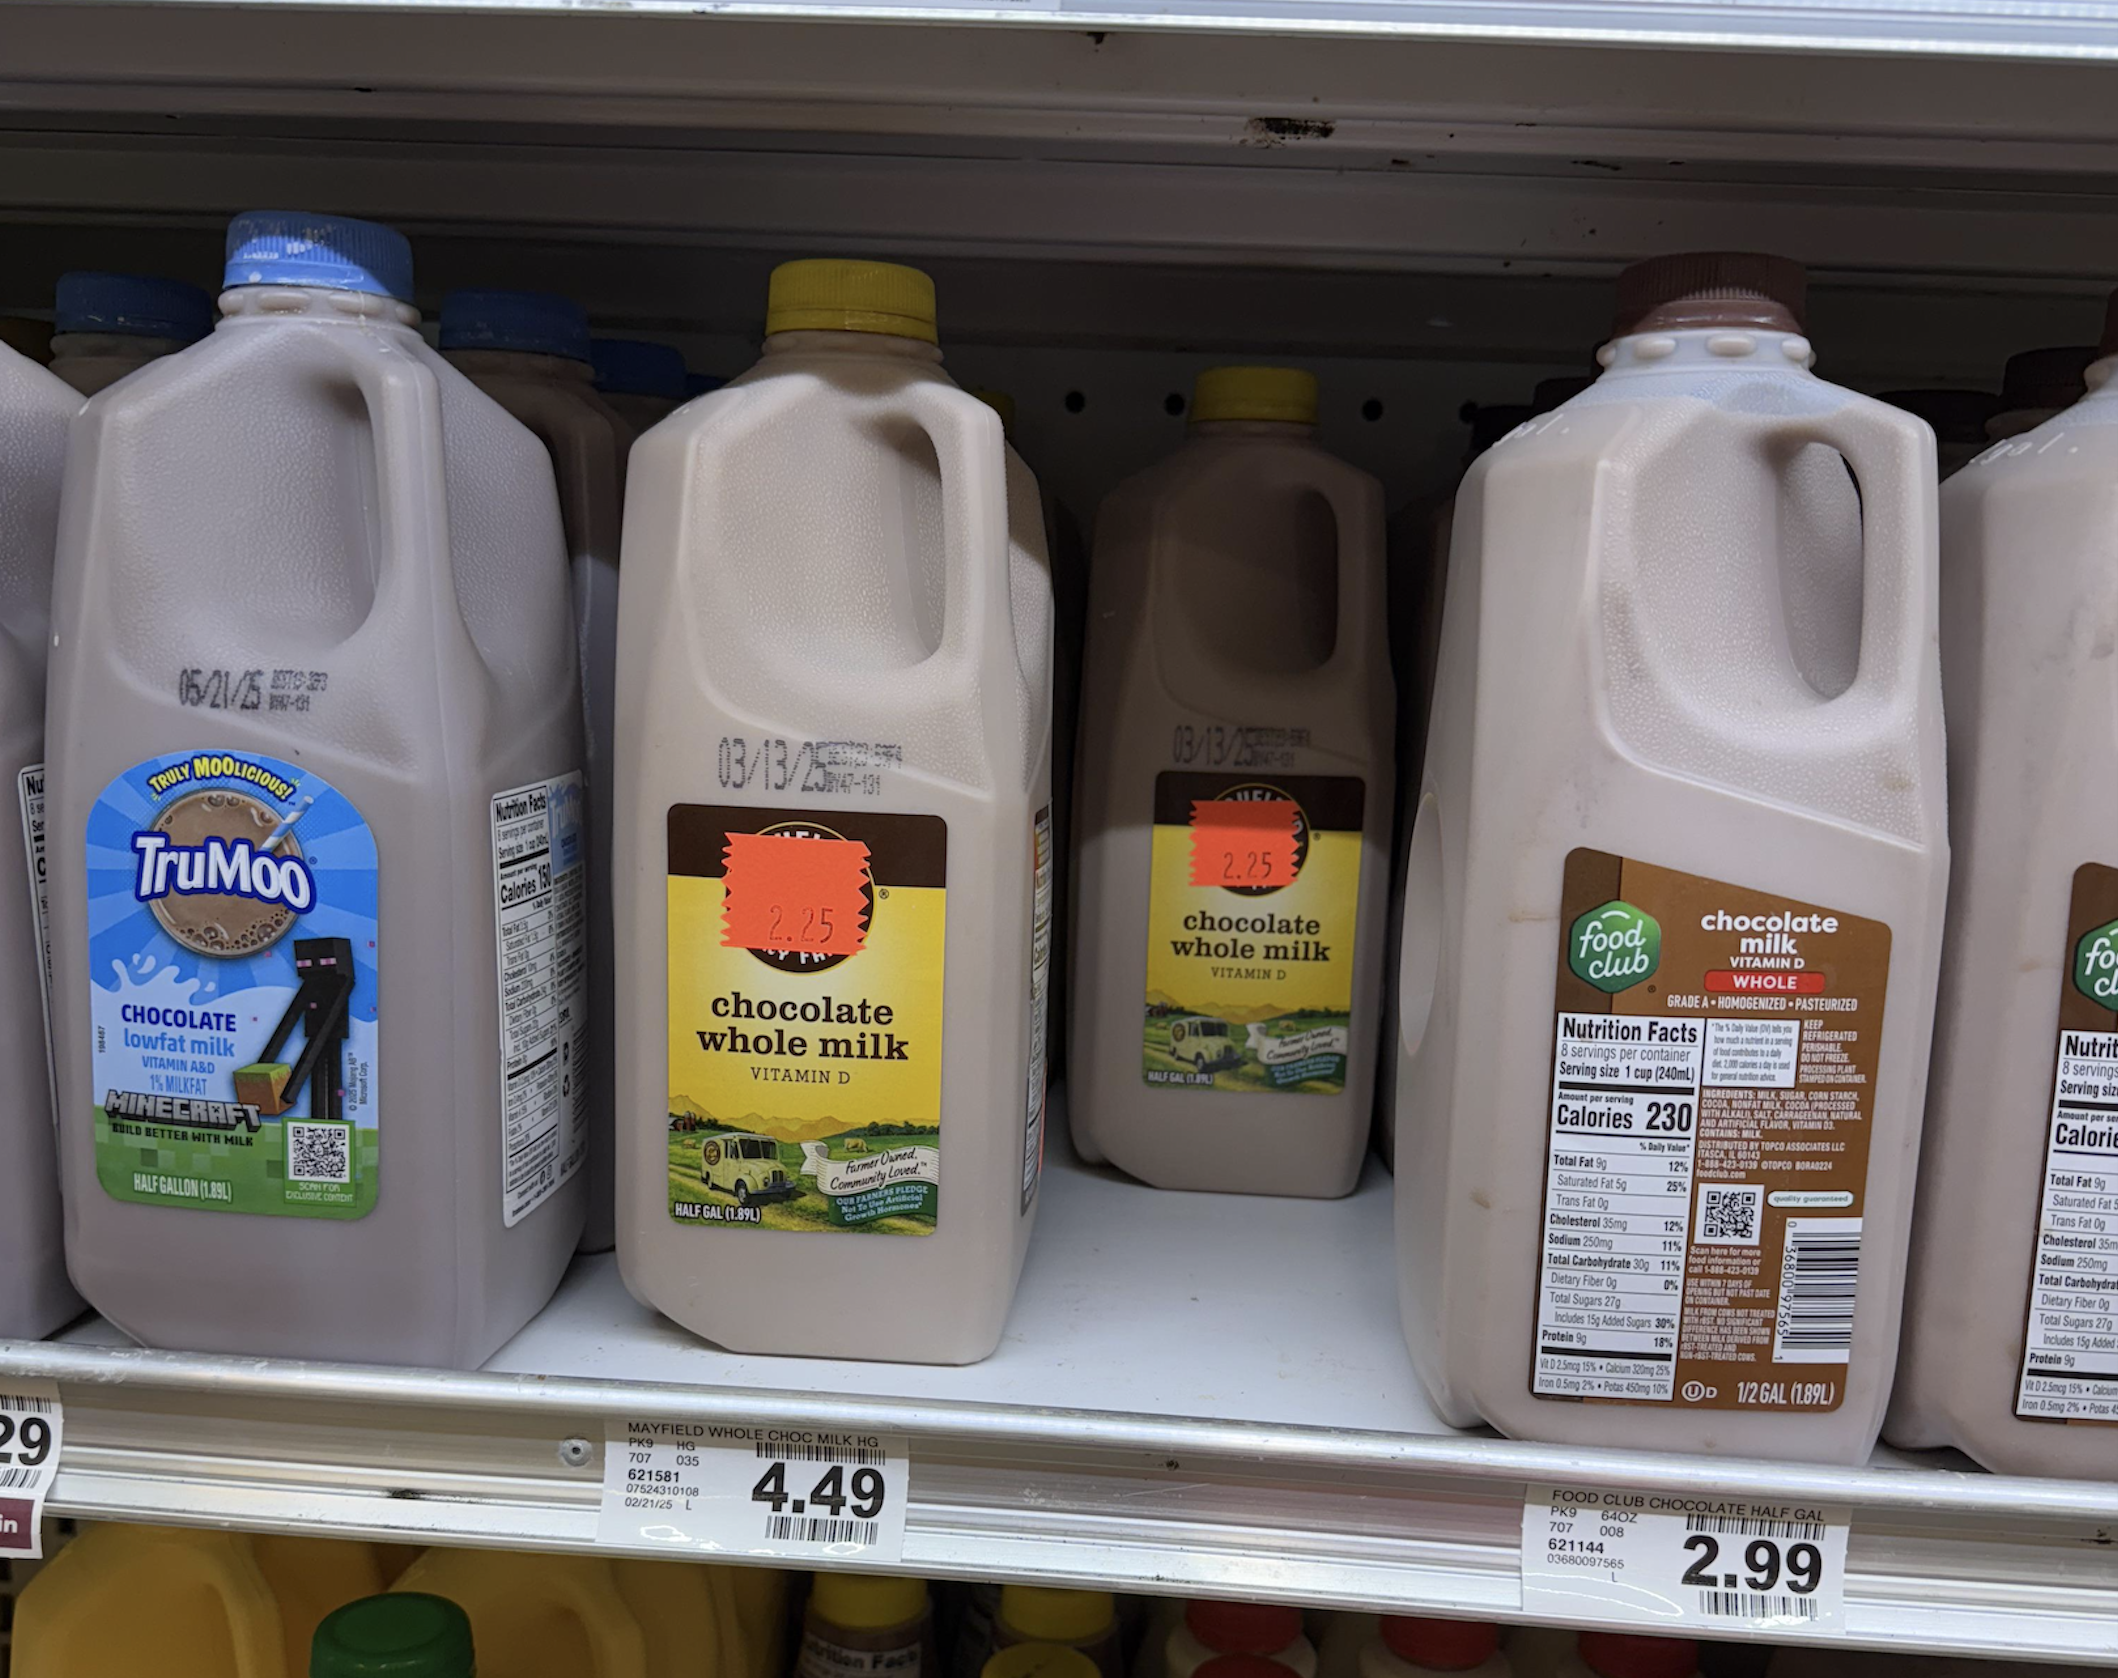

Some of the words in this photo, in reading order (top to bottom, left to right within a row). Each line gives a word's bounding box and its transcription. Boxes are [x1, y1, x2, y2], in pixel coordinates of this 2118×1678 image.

[179, 668, 264, 710] 05/21/25
[718, 737, 826, 793] 03/13/25
[149, 766, 190, 793] TRULY
[193, 757, 295, 799] MOOLICIOUS!
[496, 797, 527, 823] Nutrition
[529, 795, 547, 813] Facts
[134, 835, 312, 910] TruMoo
[1223, 851, 1272, 880] 2.25
[501, 878, 537, 904] Calories
[770, 905, 834, 943] 2.25
[1183, 910, 1320, 935] chocolate
[1701, 910, 1838, 933] chocolate
[1579, 919, 1647, 958] food
[1740, 934, 1798, 955] milk
[1171, 937, 1254, 959] whole
[1263, 940, 1330, 962] milk
[1588, 948, 1649, 979] club
[1729, 957, 1791, 969] VITAMIN
[1794, 959, 1805, 969] D
[1211, 967, 1271, 980] VITAMIN
[1277, 969, 1286, 980] D
[1733, 975, 1797, 990] WHOLE
[712, 992, 894, 1024] chocolate
[1668, 995, 1700, 1008] GRADE
[1701, 996, 1709, 1008] A
[1717, 996, 1786, 1010] HOMOGENIZED
[1795, 998, 1858, 1012] PASTEURIZED
[121, 1004, 236, 1032] CHOCOLATE
[1803, 1020, 1823, 1029] KEEP
[1563, 1017, 1641, 1041] Nutrition
[1648, 1021, 1697, 1043] Facts
[1803, 1031, 1857, 1042] REFRIGERATED
[124, 1028, 185, 1054] lowfat
[191, 1037, 235, 1057] milk
[697, 1026, 808, 1056] whole
[818, 1032, 909, 1060] milk
[1561, 1043, 1568, 1057] 8
[1571, 1044, 1617, 1062] servings
[1620, 1049, 1637, 1062] per
[1640, 1049, 1690, 1062] container
[142, 1055, 187, 1073] VITAMIN
[190, 1061, 215, 1074] A&D
[1560, 1062, 1596, 1079] Serving
[1600, 1064, 1619, 1078] size
[1626, 1066, 1630, 1078] 1
[1634, 1068, 1652, 1082] cup
[1655, 1066, 1695, 1084] (240mL)
[2062, 1061, 2070, 1075] 8
[150, 1074, 164, 1092] 1%
[166, 1075, 207, 1096] MILKFAT
[750, 1067, 830, 1084] VITAMIN
[838, 1071, 850, 1084] D
[1147, 1071, 1168, 1082] HALF
[1170, 1074, 1185, 1083] GAL
[1558, 1091, 1588, 1102] Amount
[1590, 1095, 1603, 1103] per
[1605, 1095, 1633, 1105] serving
[105, 1089, 261, 1132] MINECRAFT
[1557, 1104, 1633, 1129] Calories
[1646, 1102, 1692, 1132] 230
[112, 1122, 142, 1137] BUILD
[145, 1126, 189, 1141] BETTER
[192, 1131, 221, 1145] WITH
[225, 1134, 253, 1147] MILK
[846, 1159, 879, 1175] Farmer
[880, 1148, 917, 1166] Owned.
[1554, 1154, 1577, 1167] Total
[1579, 1156, 1594, 1168] Fat
[1596, 1157, 1607, 1170] 9g
[1669, 1162, 1688, 1173] 12%
[133, 1173, 157, 1193] HALF
[159, 1175, 199, 1198] GALLON
[200, 1180, 233, 1203] (1.89L)
[299, 1182, 318, 1192] SCAN
[830, 1171, 886, 1190] Community
[895, 1186, 928, 1194] PLEDGE
[1557, 1174, 1599, 1188] Saturated
[1601, 1178, 1614, 1189] Fat
[1616, 1178, 1627, 1192] 5g
[1667, 1181, 1687, 1192] 25%
[2050, 1173, 2074, 1187] Total
[2076, 1176, 2092, 1188] Fat
[2094, 1177, 2106, 1191] 9g
[842, 1203, 856, 1213] Not
[858, 1203, 868, 1211] To
[869, 1199, 884, 1208] Use
[886, 1194, 923, 1204] Artificial
[1773, 1195, 1801, 1204] quality
[1803, 1195, 1848, 1204] guaranteed
[675, 1202, 700, 1218] HALF
[702, 1206, 723, 1220] GAL
[725, 1206, 761, 1223] (1.89L)
[844, 1209, 876, 1221] Growth
[1550, 1214, 1600, 1228] Cholesterol
[1603, 1217, 1627, 1231] 35mg
[1664, 1221, 1683, 1232] 12%
[1548, 1233, 1580, 1246] Sodium
[1583, 1236, 1613, 1250] 250mg
[1662, 1241, 1681, 1252] 11%
[1781, 1246, 1797, 1289] 36800
[1777, 1294, 1793, 1337] 97565
[1542, 1330, 1573, 1343] Protein
[1576, 1332, 1587, 1346] 9g
[1654, 1337, 1673, 1348] 18%
[2029, 1353, 2062, 1366] Protein
[2064, 1355, 2075, 1368] 9g
[1737, 1382, 1757, 1404] 1/2
[1760, 1383, 1787, 1405] GAL
[1790, 1382, 1835, 1406] (1.89L)
[628, 1422, 704, 1437] MAYFIELD
[709, 1426, 763, 1441] WHOLE
[768, 1429, 812, 1443] CHOC
[817, 1434, 852, 1446] MILK
[857, 1436, 878, 1448] HG
[629, 1437, 653, 1448] PK9
[677, 1441, 695, 1451] HG
[629, 1453, 651, 1463] 707
[676, 1455, 699, 1467] 035
[628, 1469, 679, 1483] 621581
[626, 1484, 699, 1497] 07524310108
[751, 1461, 885, 1519] 4.49
[625, 1497, 672, 1510] 02/21/25
[685, 1500, 692, 1511] L
[1550, 1506, 1577, 1518] PK9
[1552, 1490, 1599, 1504] FOOD
[1603, 1494, 1645, 1508] CLUB
[1649, 1497, 1746, 1516] CHOCOLATE
[1751, 1506, 1789, 1519] HALF
[1794, 1508, 1824, 1522] GAL
[1549, 1522, 1573, 1533] 707
[1600, 1525, 1624, 1538] 008
[1548, 1538, 1604, 1554] 621144
[1547, 1553, 1624, 1569] 03680097565
[1681, 1535, 1822, 1595] 2.99
[1611, 1572, 1618, 1583] L
